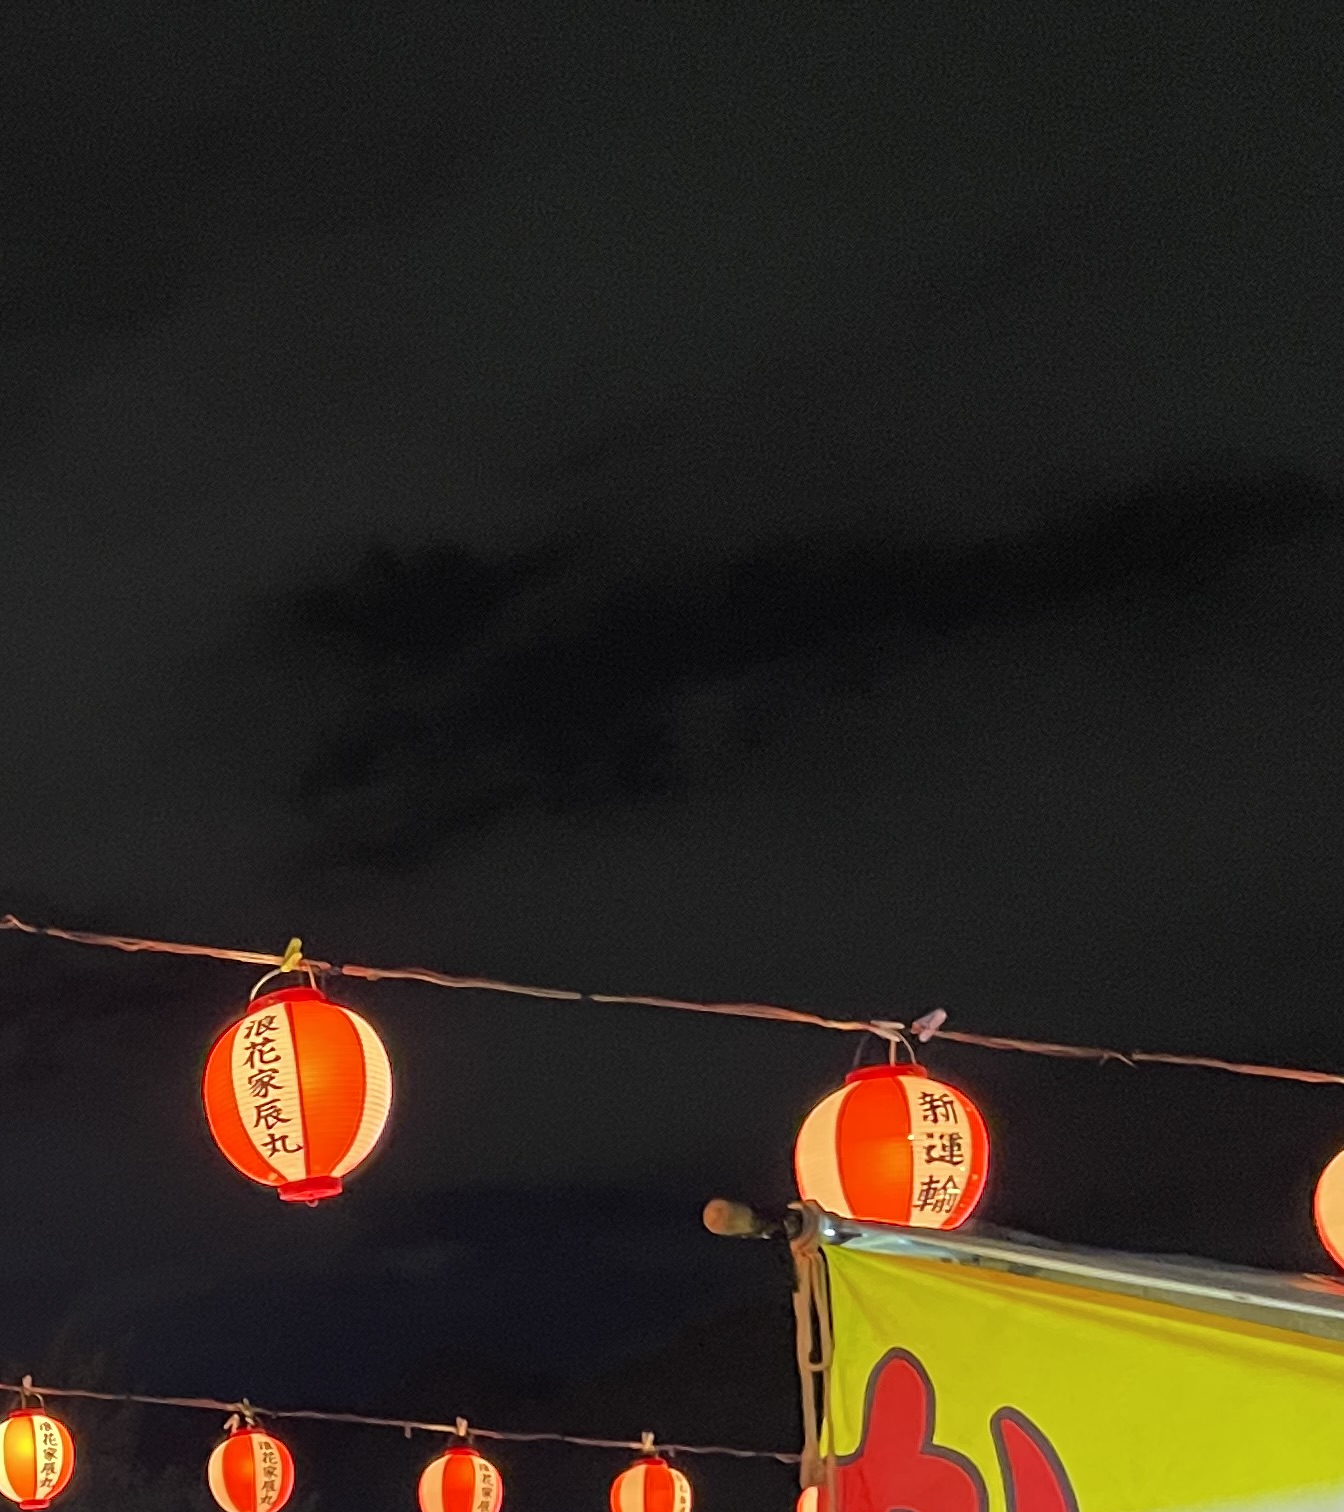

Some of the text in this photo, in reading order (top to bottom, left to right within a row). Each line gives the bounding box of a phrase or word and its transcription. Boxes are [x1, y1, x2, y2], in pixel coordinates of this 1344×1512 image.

[241, 1014, 304, 1158] 浪花家辰丸
[912, 1091, 964, 1214] 新運輸
